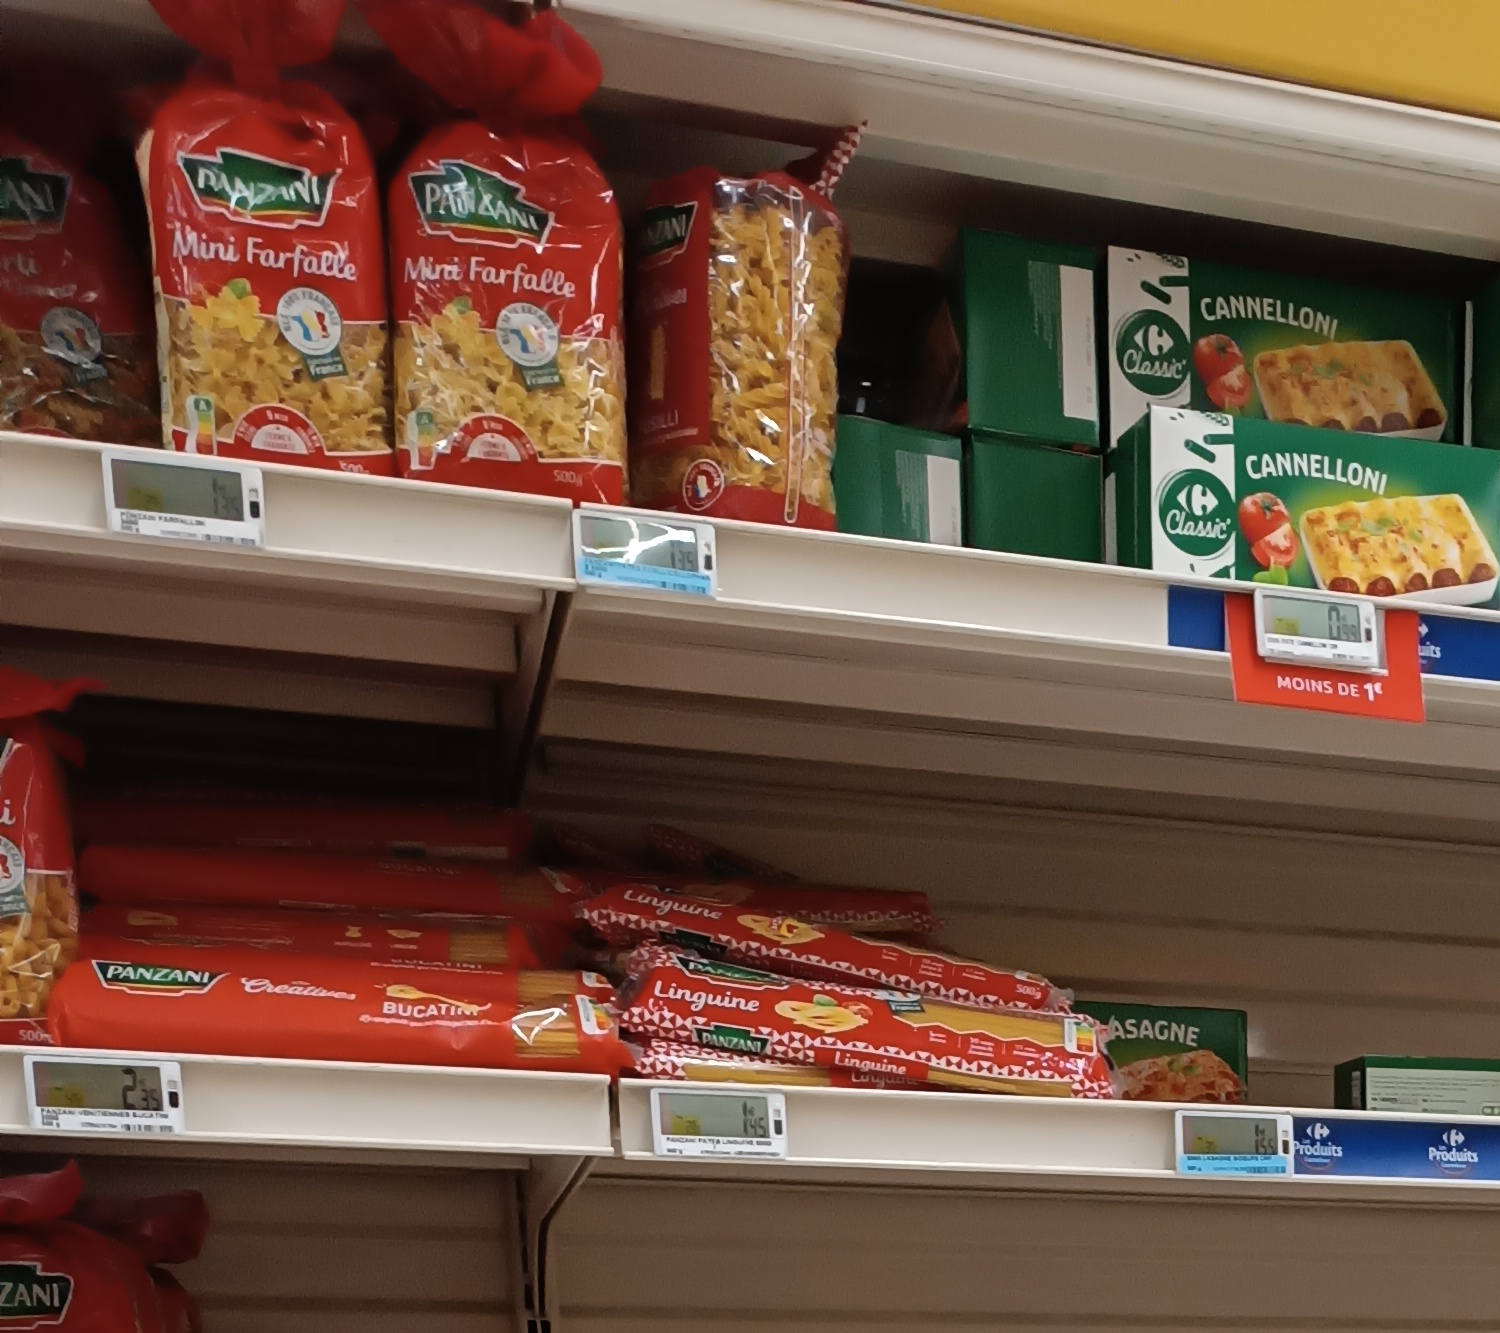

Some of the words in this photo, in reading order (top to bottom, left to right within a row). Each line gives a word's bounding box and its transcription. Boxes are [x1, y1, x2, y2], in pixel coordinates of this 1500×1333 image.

[425, 182, 538, 231] PANZANI
[173, 225, 239, 262] Mini
[247, 237, 357, 282] Farfalle
[404, 256, 464, 282] Mini
[470, 257, 576, 298] Farfalle
[1200, 296, 1338, 340] CANNELLONI
[1245, 453, 1388, 496] CANNELLONI
[1277, 675, 1333, 696] MOINS
[1338, 681, 1359, 698] DE
[622, 887, 723, 921] Linguine
[106, 964, 210, 986] PANZANI
[654, 979, 760, 1014] Linguine
[701, 1031, 763, 1054] PANZANI
[834, 1050, 907, 1076] Linguine
[1293, 1141, 1343, 1158] Produits
[1429, 1147, 1479, 1164] Produits
